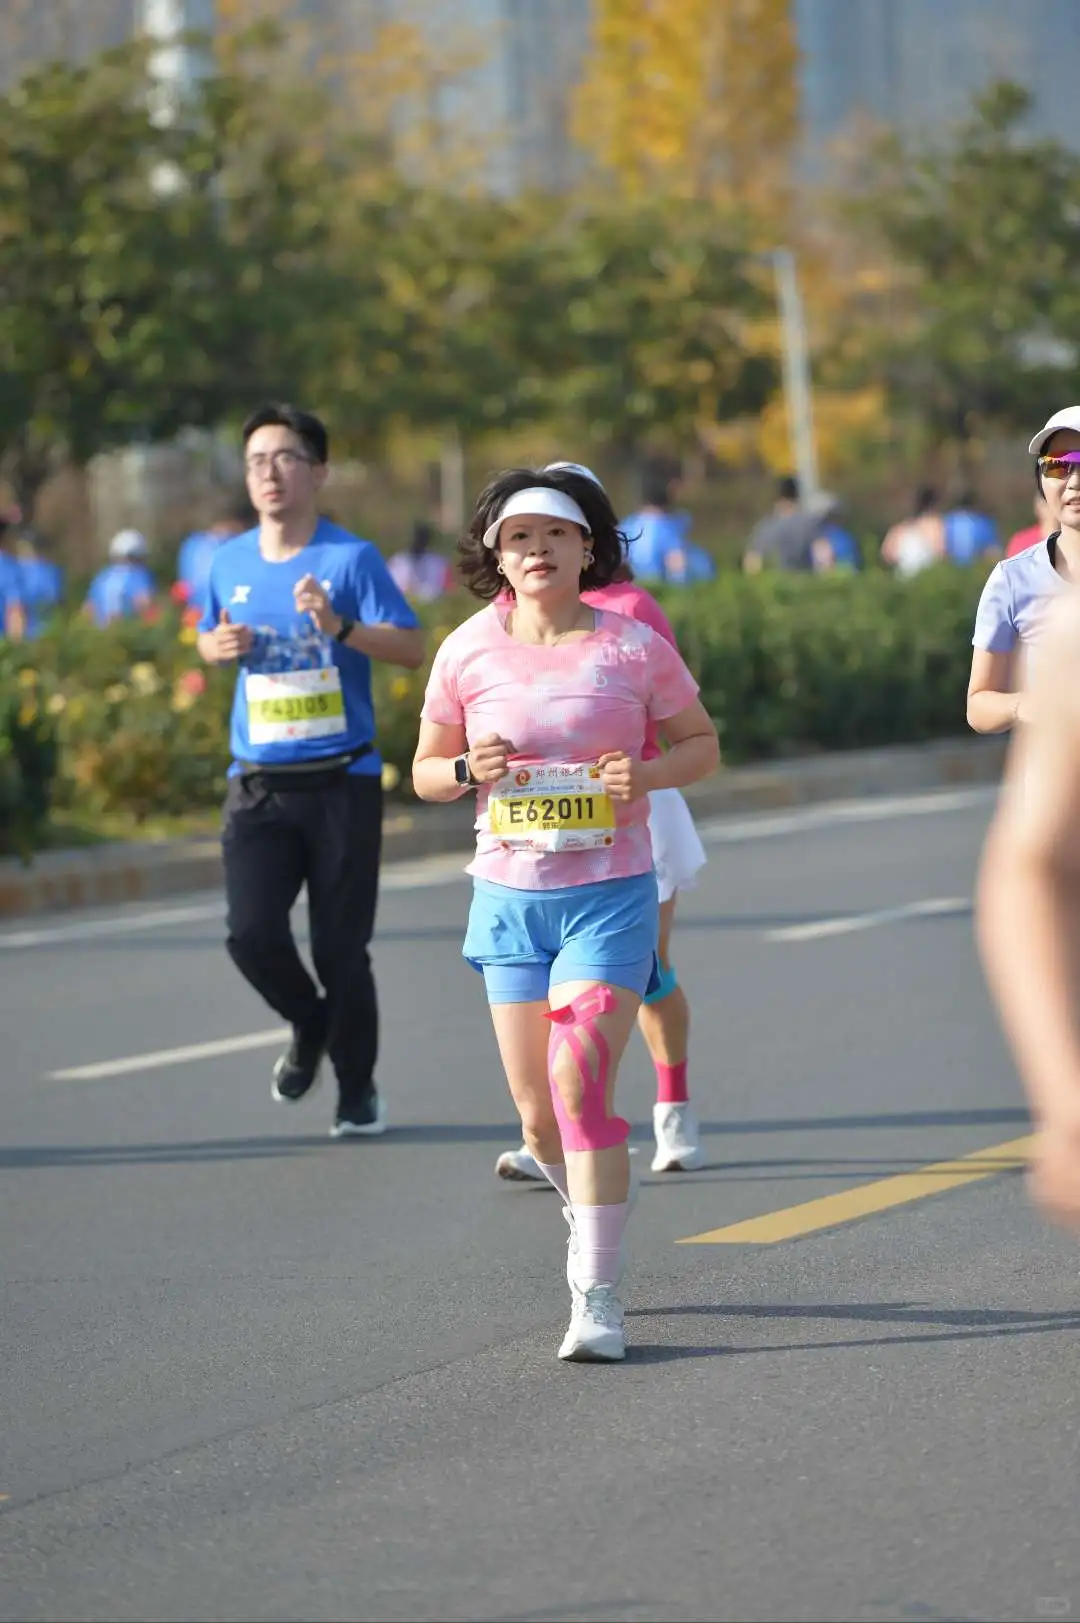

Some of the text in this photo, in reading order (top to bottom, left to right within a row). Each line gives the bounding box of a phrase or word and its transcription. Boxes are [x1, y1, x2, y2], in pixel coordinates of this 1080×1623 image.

[535, 767, 584, 778] 郑州银行
[509, 797, 593, 823] E62011
